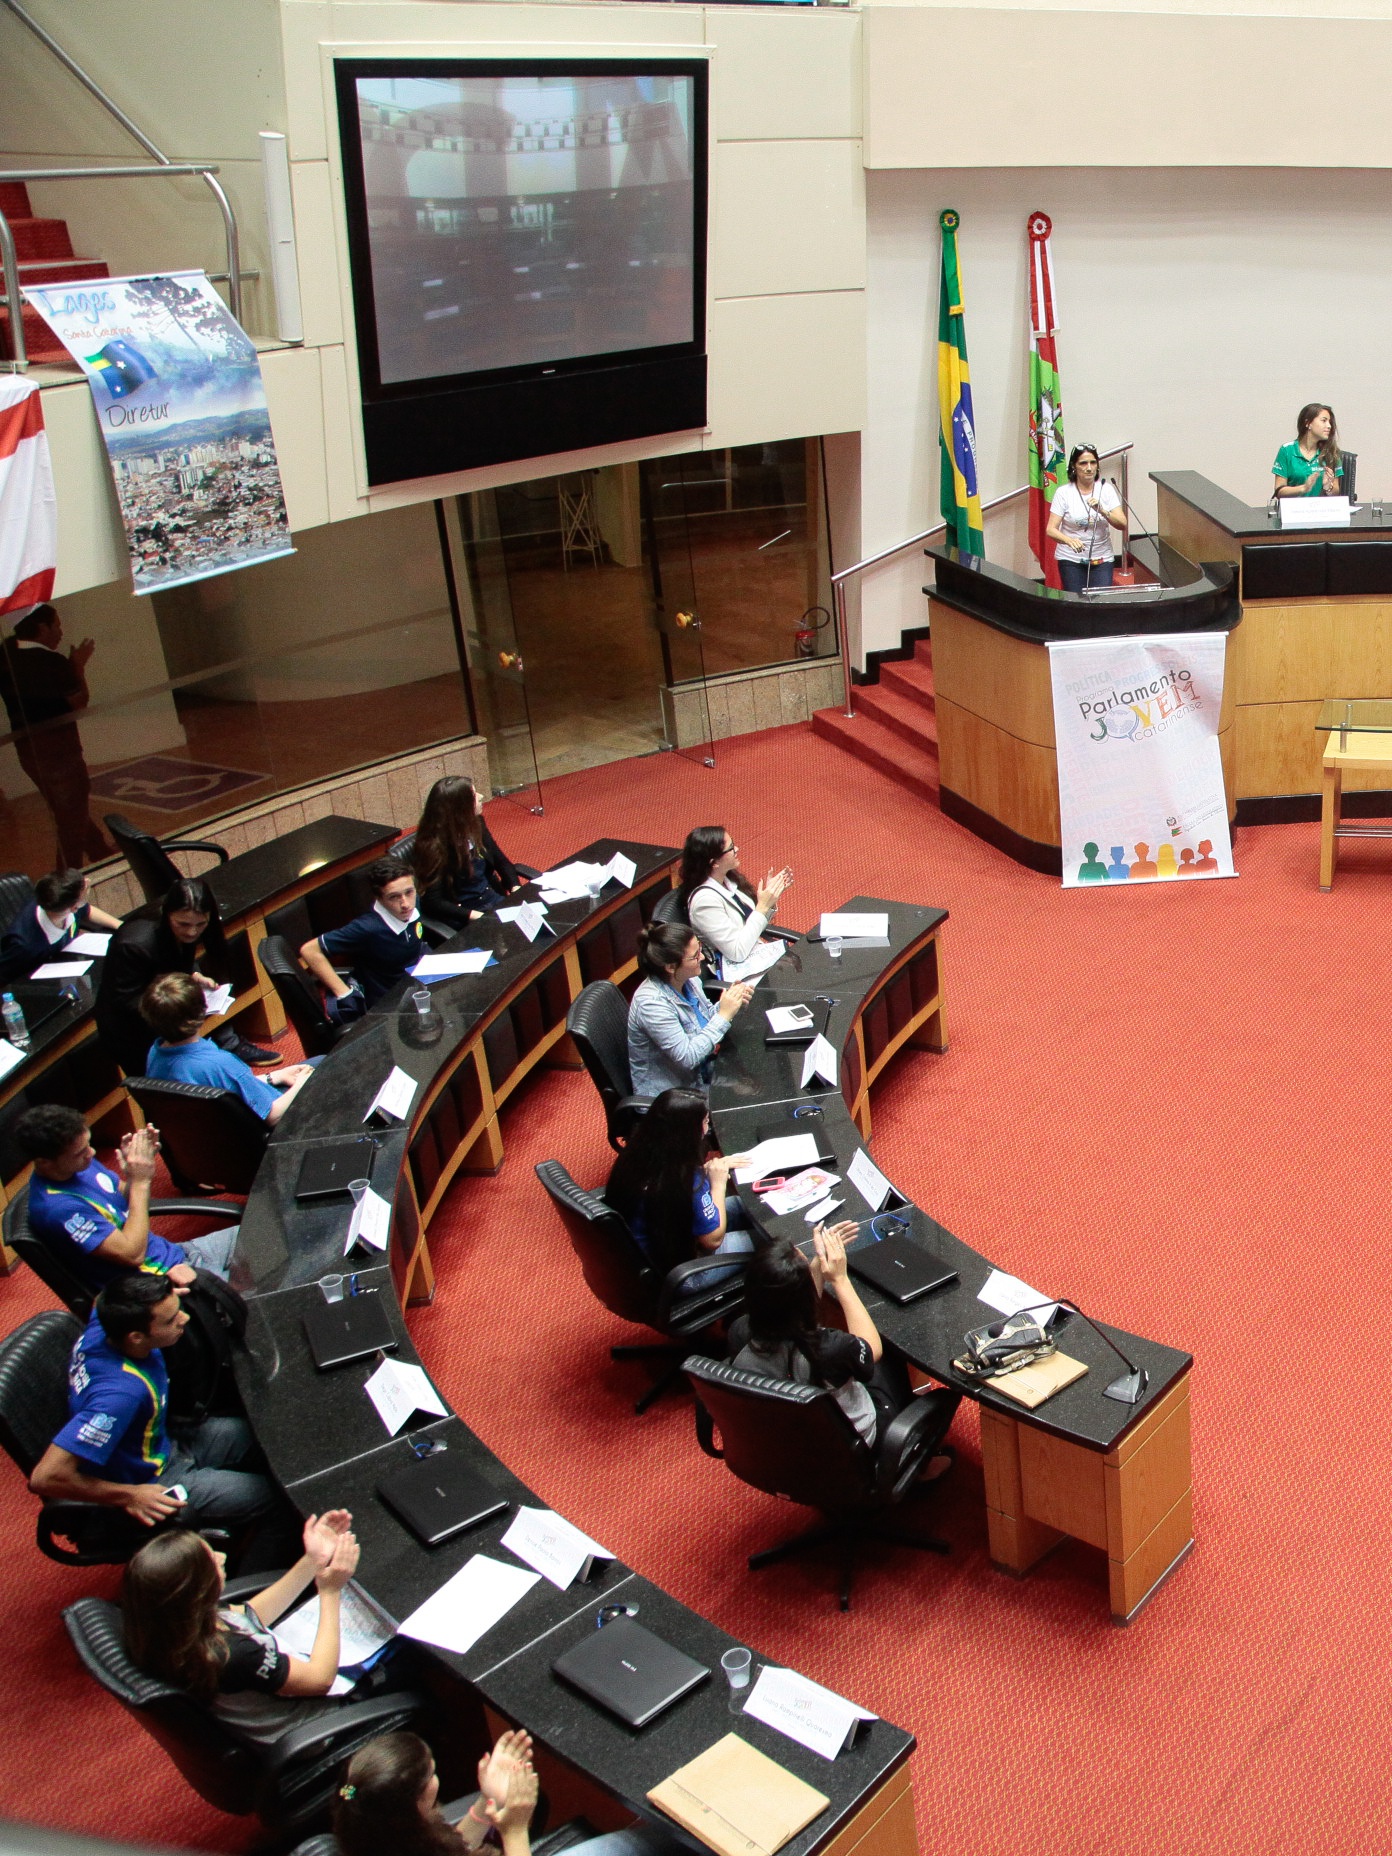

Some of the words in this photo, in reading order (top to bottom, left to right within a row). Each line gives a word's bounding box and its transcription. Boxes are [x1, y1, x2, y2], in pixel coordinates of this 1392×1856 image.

[38, 289, 116, 324] Lages
[1079, 670, 1191, 719] Parlamento
[1090, 681, 1200, 743] JOVEM
[1134, 701, 1203, 741] catarinense
